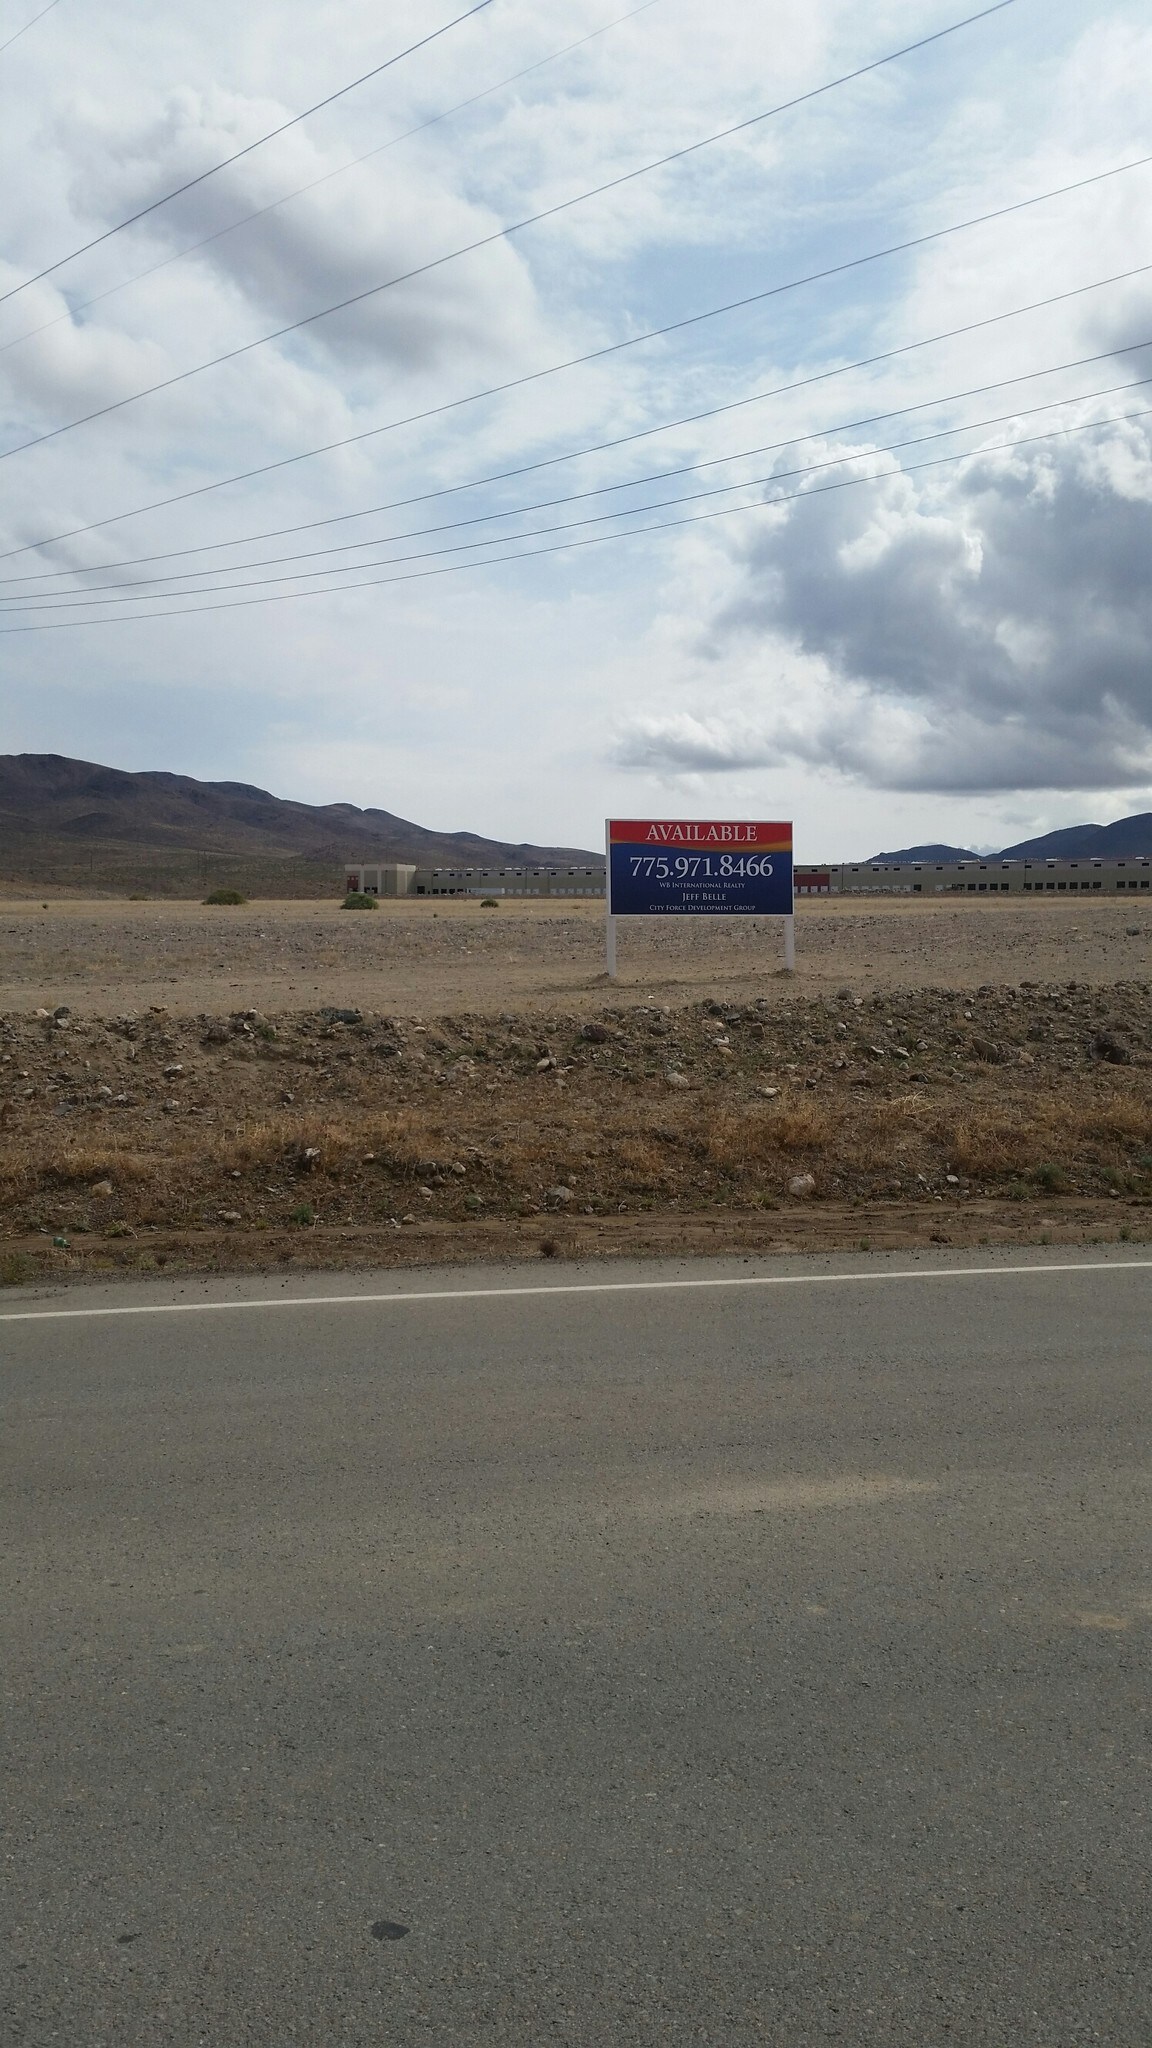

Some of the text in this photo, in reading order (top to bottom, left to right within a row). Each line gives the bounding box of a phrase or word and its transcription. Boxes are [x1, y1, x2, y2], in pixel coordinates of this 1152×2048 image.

[645, 825, 758, 841] AVAILABLE
[629, 854, 774, 879] 775.971.8466
[682, 893, 727, 902] JEFF BELLE
